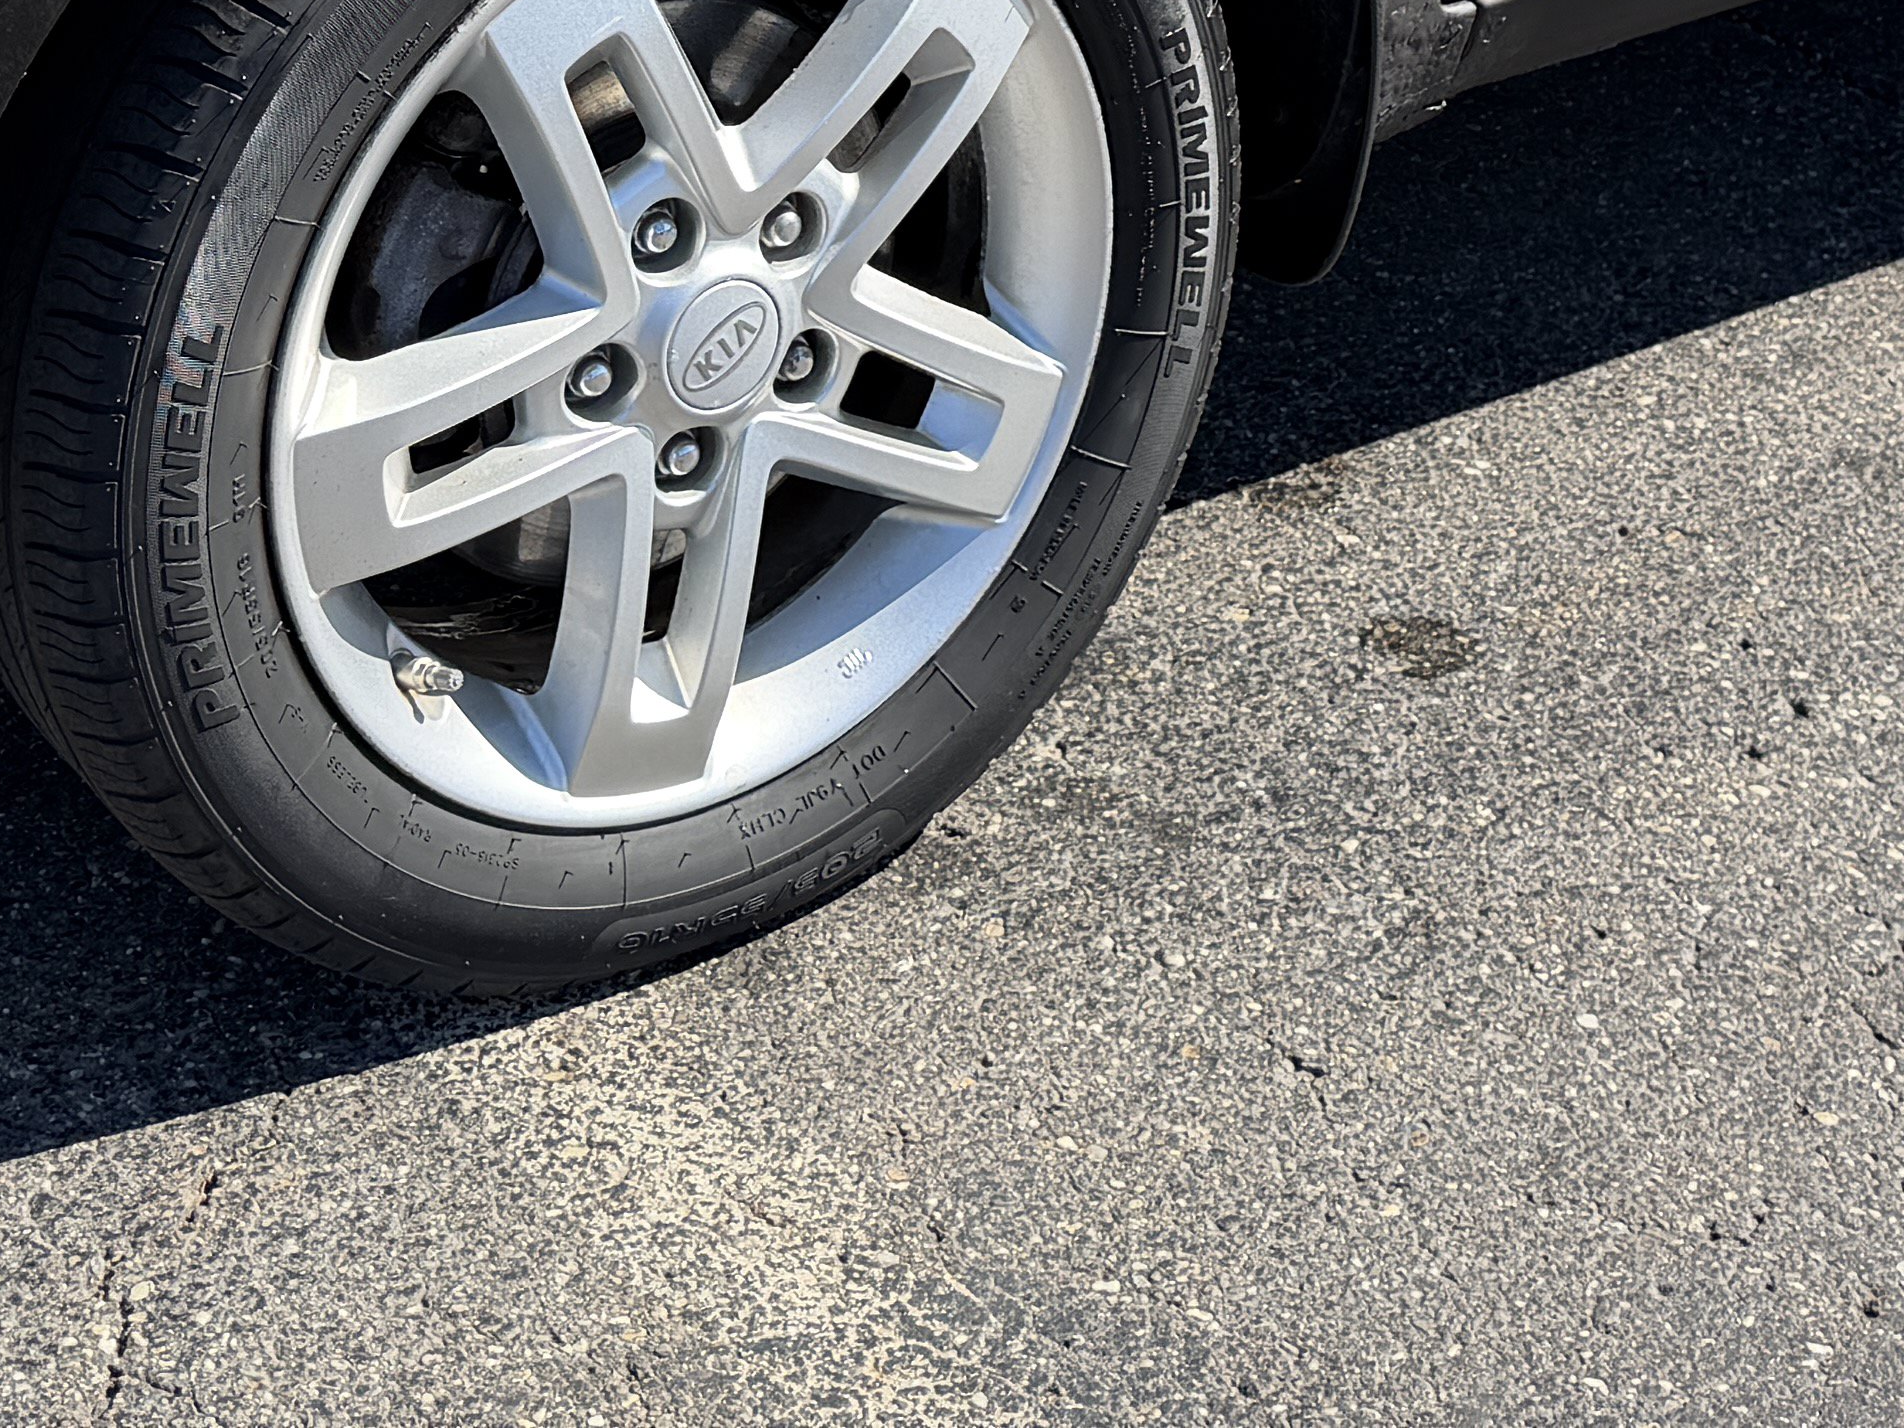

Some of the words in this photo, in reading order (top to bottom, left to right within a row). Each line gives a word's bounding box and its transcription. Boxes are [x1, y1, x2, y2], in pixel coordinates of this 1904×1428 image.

[694, 319, 758, 382] KIA
[1159, 27, 1211, 378] PRIMEWELL
[158, 324, 241, 733] PRIMEWELL
